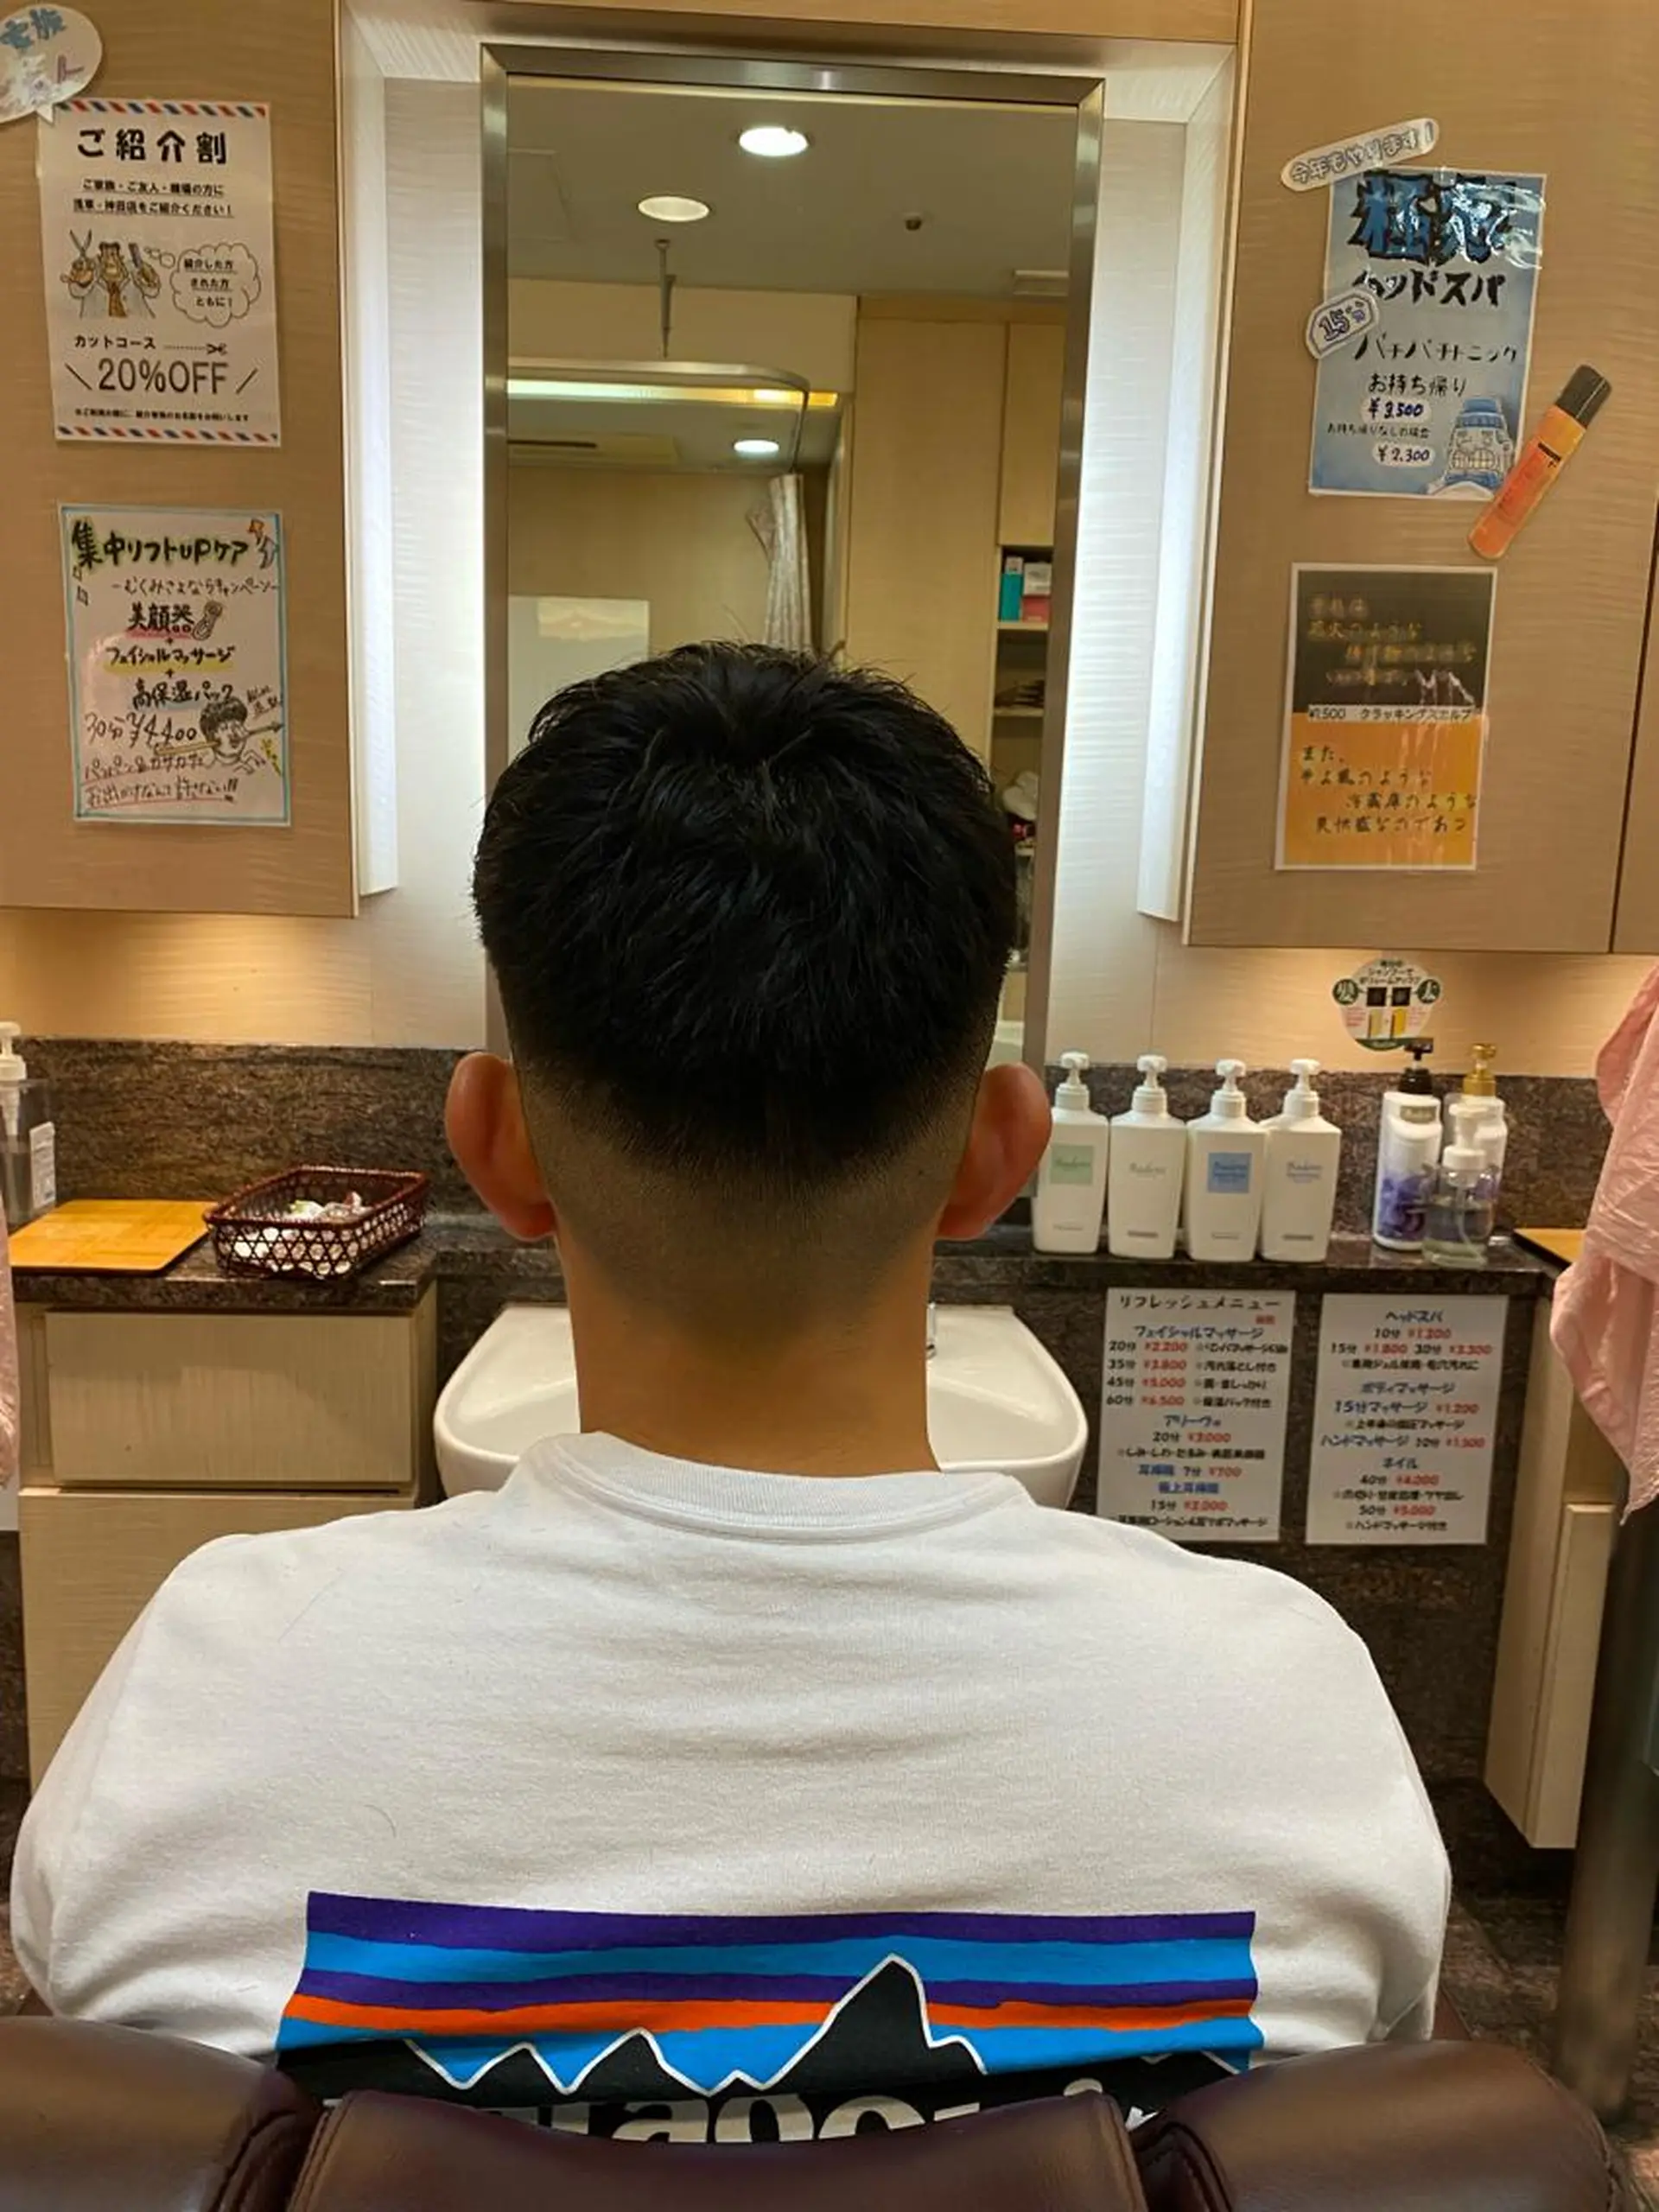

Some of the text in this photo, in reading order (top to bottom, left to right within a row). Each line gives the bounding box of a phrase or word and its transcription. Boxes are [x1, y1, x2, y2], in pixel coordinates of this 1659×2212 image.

[78, 128, 226, 165] ご紹介割
[1352, 268, 1507, 307] ヘッドスパ
[75, 334, 156, 350] カットコース
[99, 358, 229, 394] 20%OFF
[1368, 372, 1467, 397] お持ち帰り
[128, 601, 194, 633] 美顔器
[105, 645, 235, 665] フェイシャルマッサージ
[1121, 1295, 1280, 1310] リフレッシュメニュー
[1135, 1325, 1264, 1339] フェイシャルマッサージ
